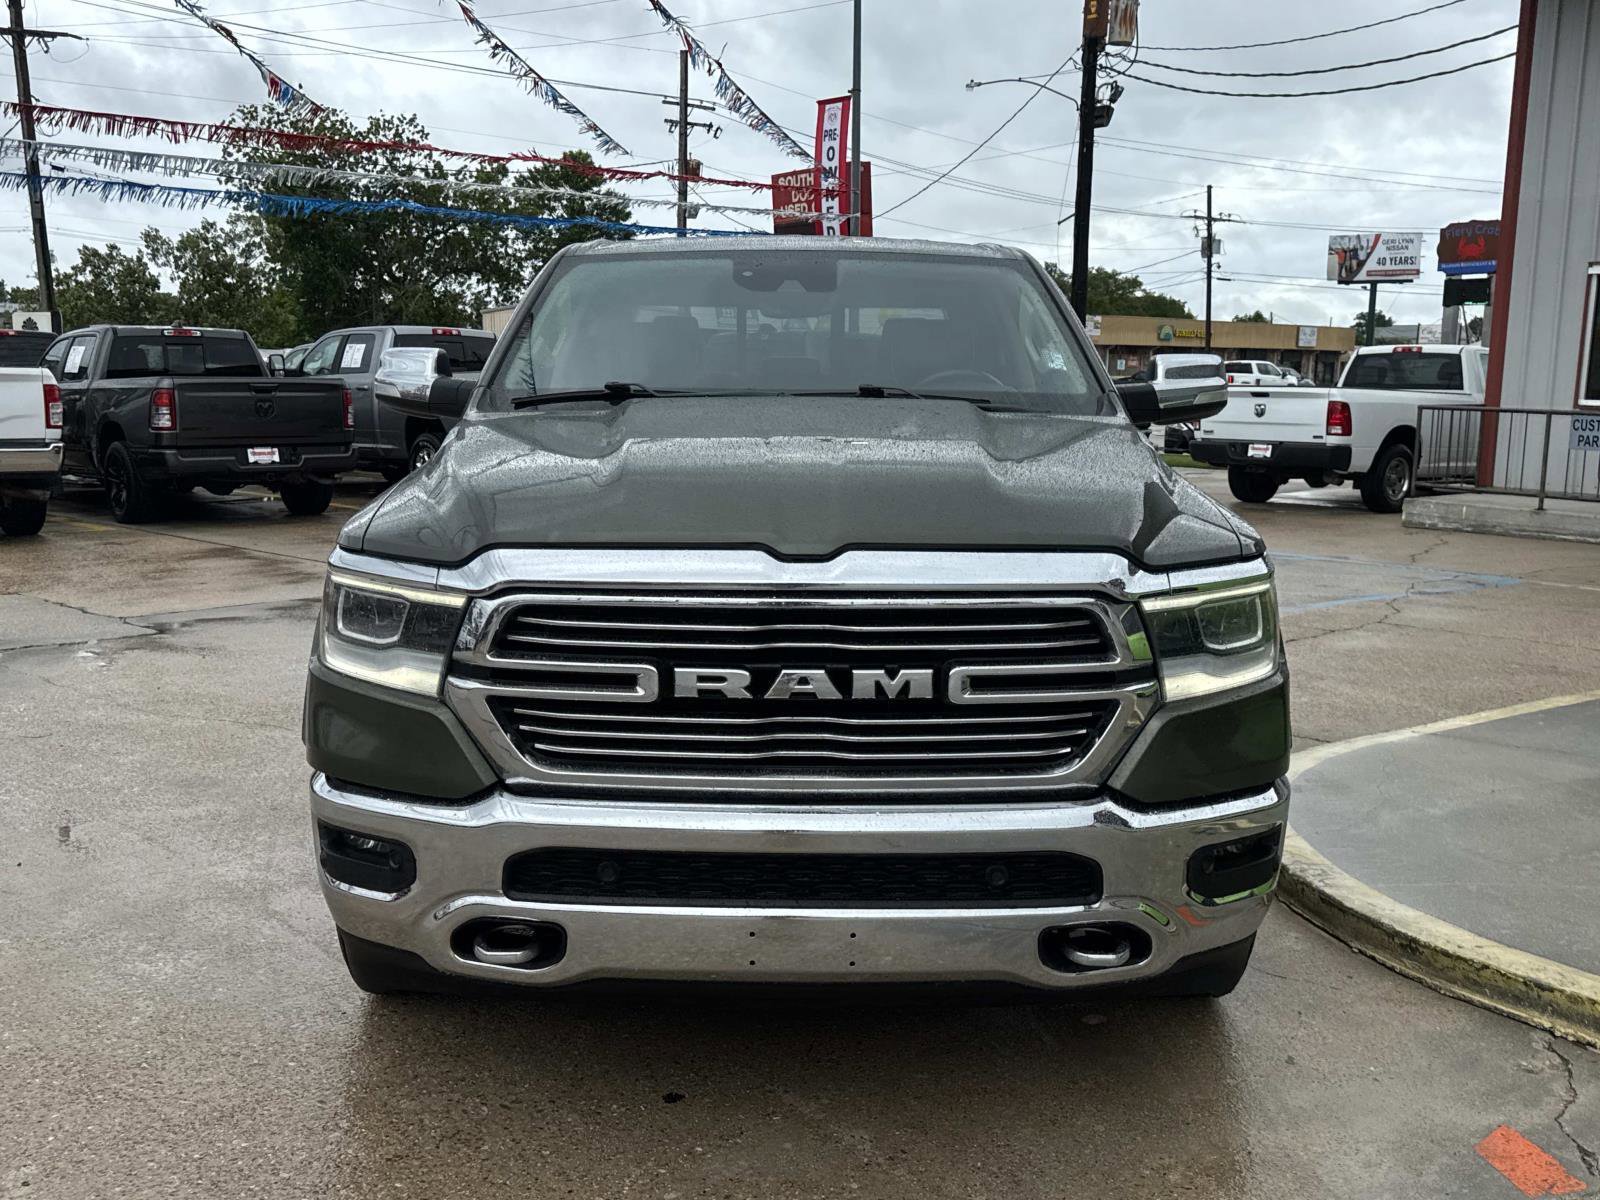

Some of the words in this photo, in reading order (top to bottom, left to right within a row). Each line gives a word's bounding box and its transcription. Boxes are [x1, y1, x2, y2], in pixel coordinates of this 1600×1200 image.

[823, 128, 839, 141] PRE-
[778, 173, 814, 187] SOUTH
[1376, 256, 1387, 266] 40
[1389, 255, 1417, 266] YEARS!
[1577, 434, 1600, 448] PAR
[673, 667, 934, 700] RAM
